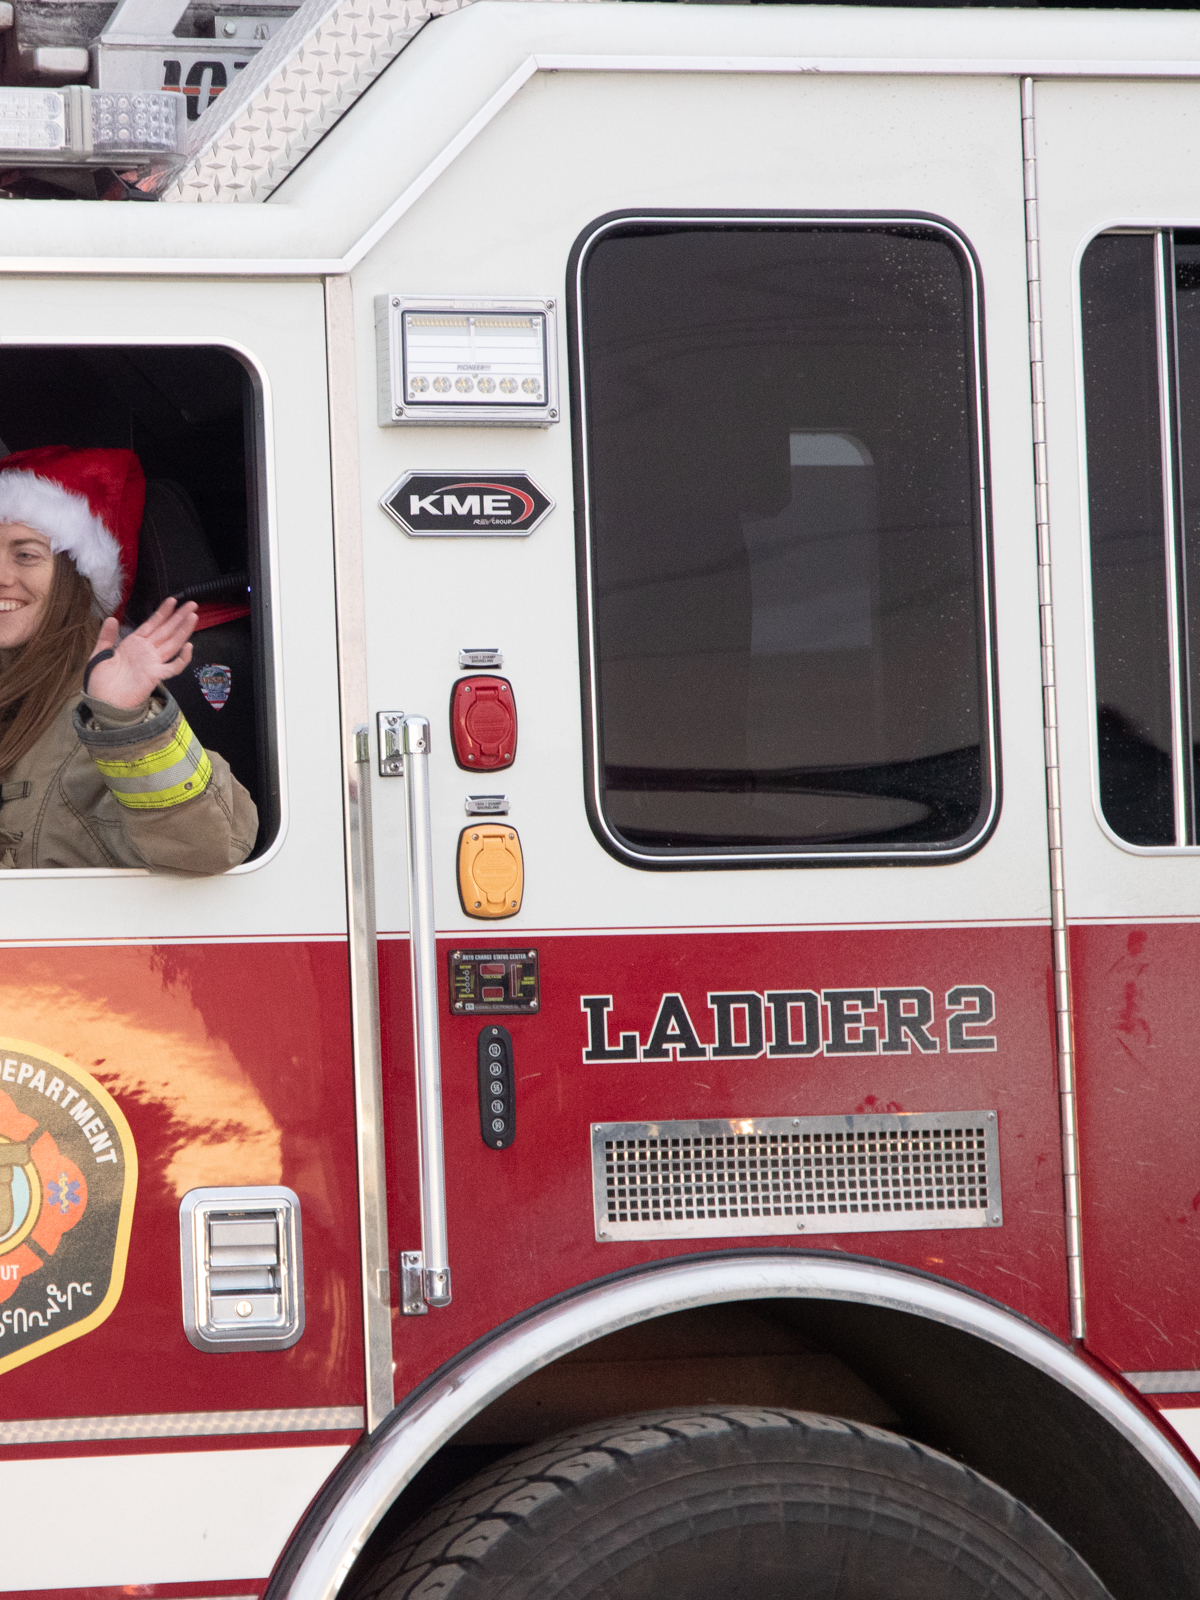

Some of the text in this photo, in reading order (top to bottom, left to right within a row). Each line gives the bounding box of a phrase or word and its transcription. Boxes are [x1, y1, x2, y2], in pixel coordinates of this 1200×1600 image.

[161, 60, 249, 122] 10
[409, 494, 512, 516] KME
[580, 984, 998, 1064] LADDER 2
